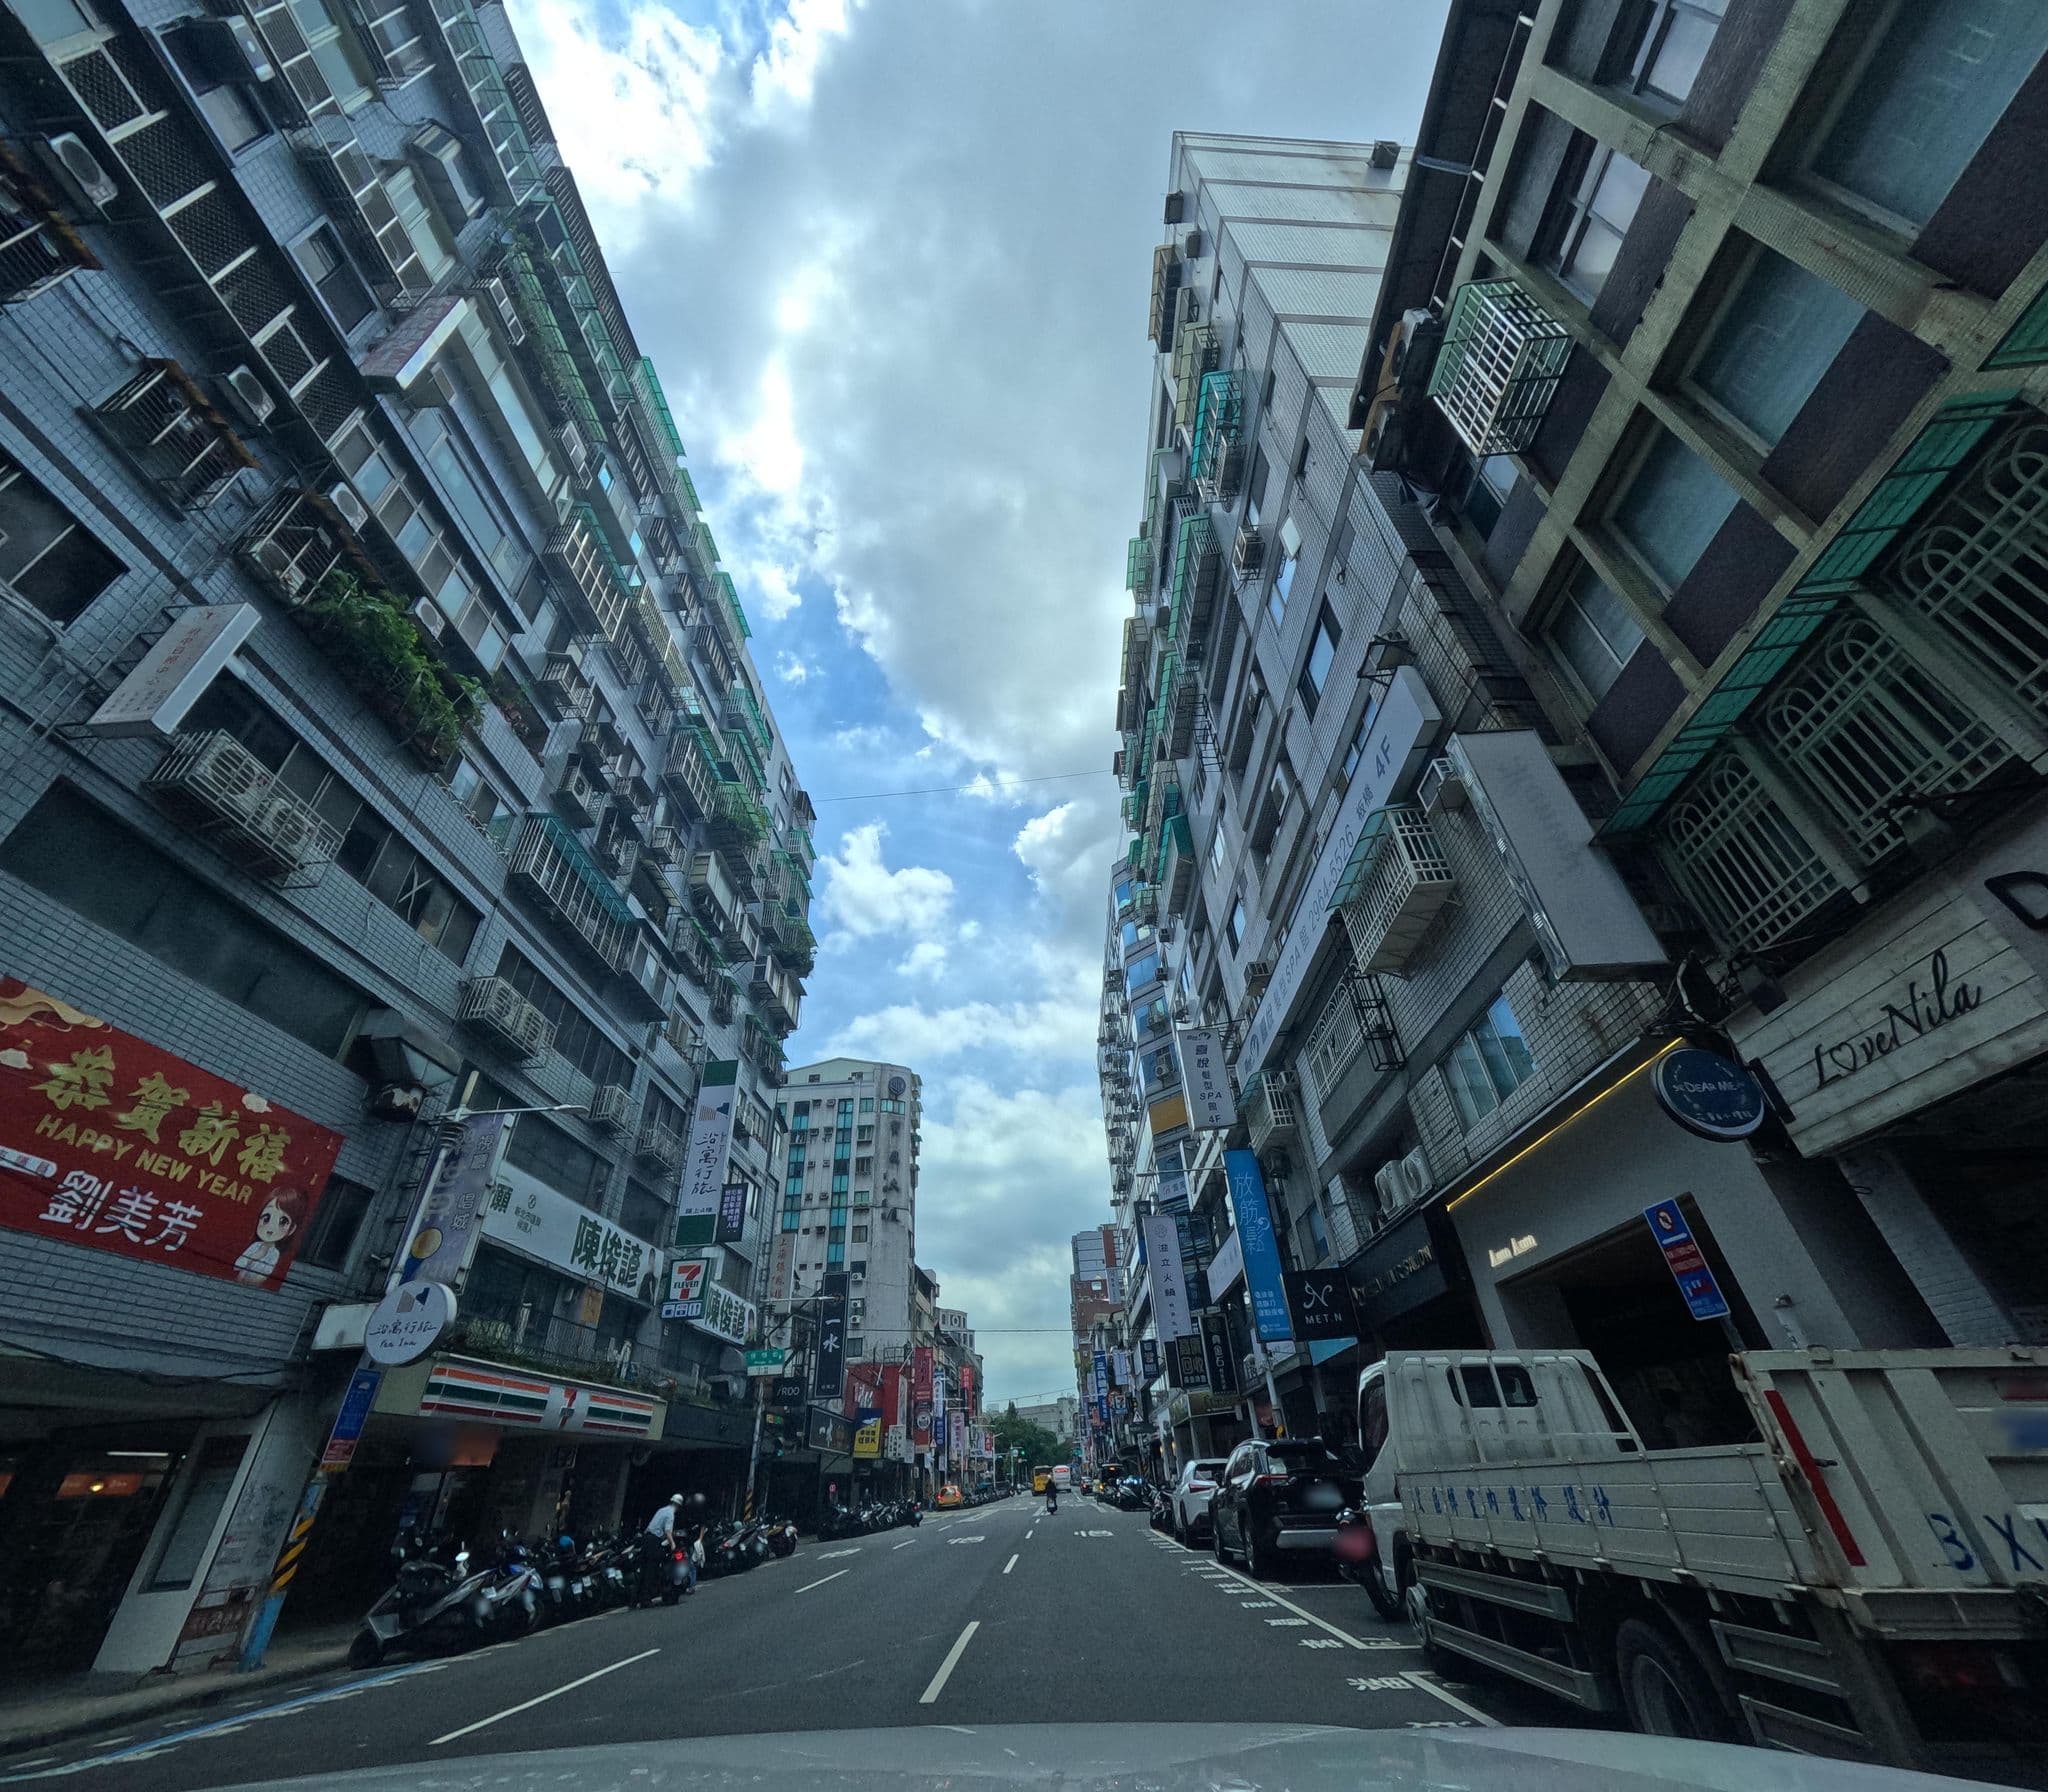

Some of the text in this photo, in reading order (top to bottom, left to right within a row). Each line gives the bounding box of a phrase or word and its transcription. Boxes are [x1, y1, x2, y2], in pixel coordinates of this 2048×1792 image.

[1375, 734, 1393, 779] 4F
[1199, 1092, 1223, 1101] SPA
[1208, 1114, 1222, 1124] 4F
[35, 1113, 135, 1163] HAPPY
[135, 1149, 195, 1183] NEW
[196, 1168, 255, 1207] YEAR
[38, 1169, 204, 1252] 劉美芳
[821, 1318, 842, 1353] 一水
